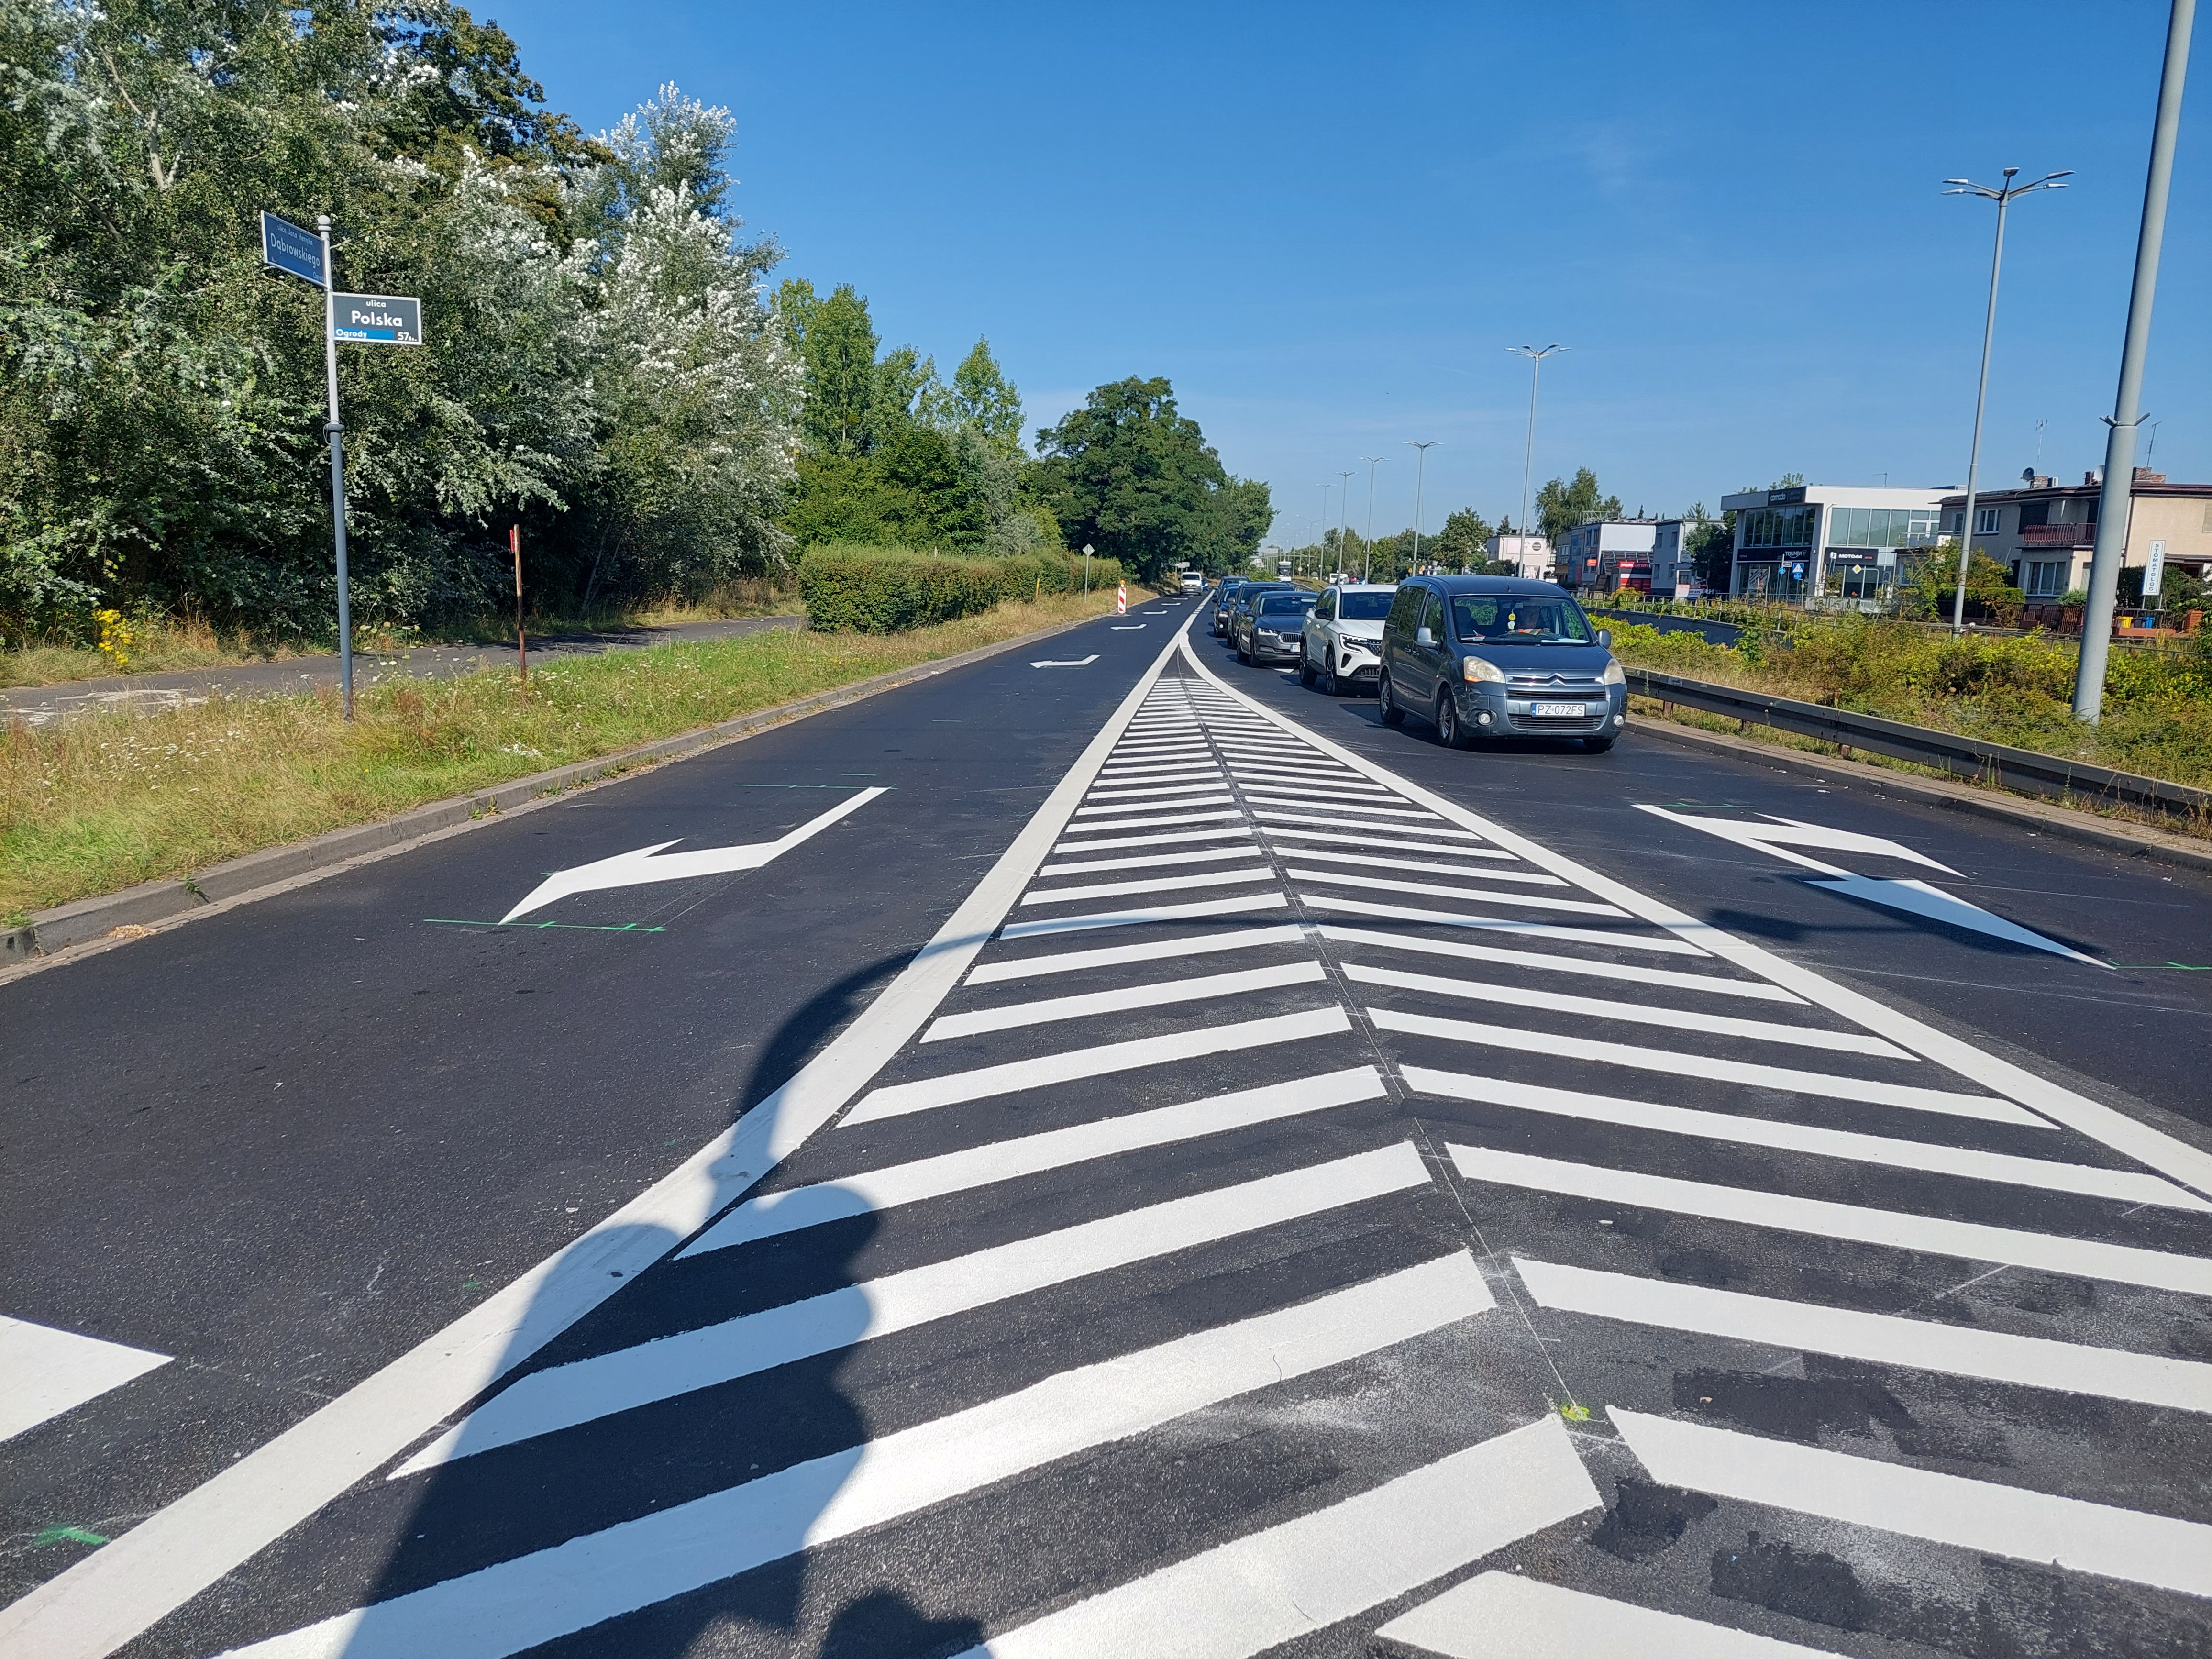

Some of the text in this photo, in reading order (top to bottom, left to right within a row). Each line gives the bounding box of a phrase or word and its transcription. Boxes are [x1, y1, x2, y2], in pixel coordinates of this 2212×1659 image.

[277, 224, 287, 233] ulica
[288, 229, 297, 238] Jana
[270, 232, 320, 268] Dąbrowskiego
[366, 299, 386, 308] ulica
[352, 310, 403, 327] Polska
[336, 329, 367, 339] Ogrody
[398, 332, 409, 341] 57
[2149, 543, 2159, 591] STOMATOLOG
[1538, 705, 1583, 715] PZ 072FS
